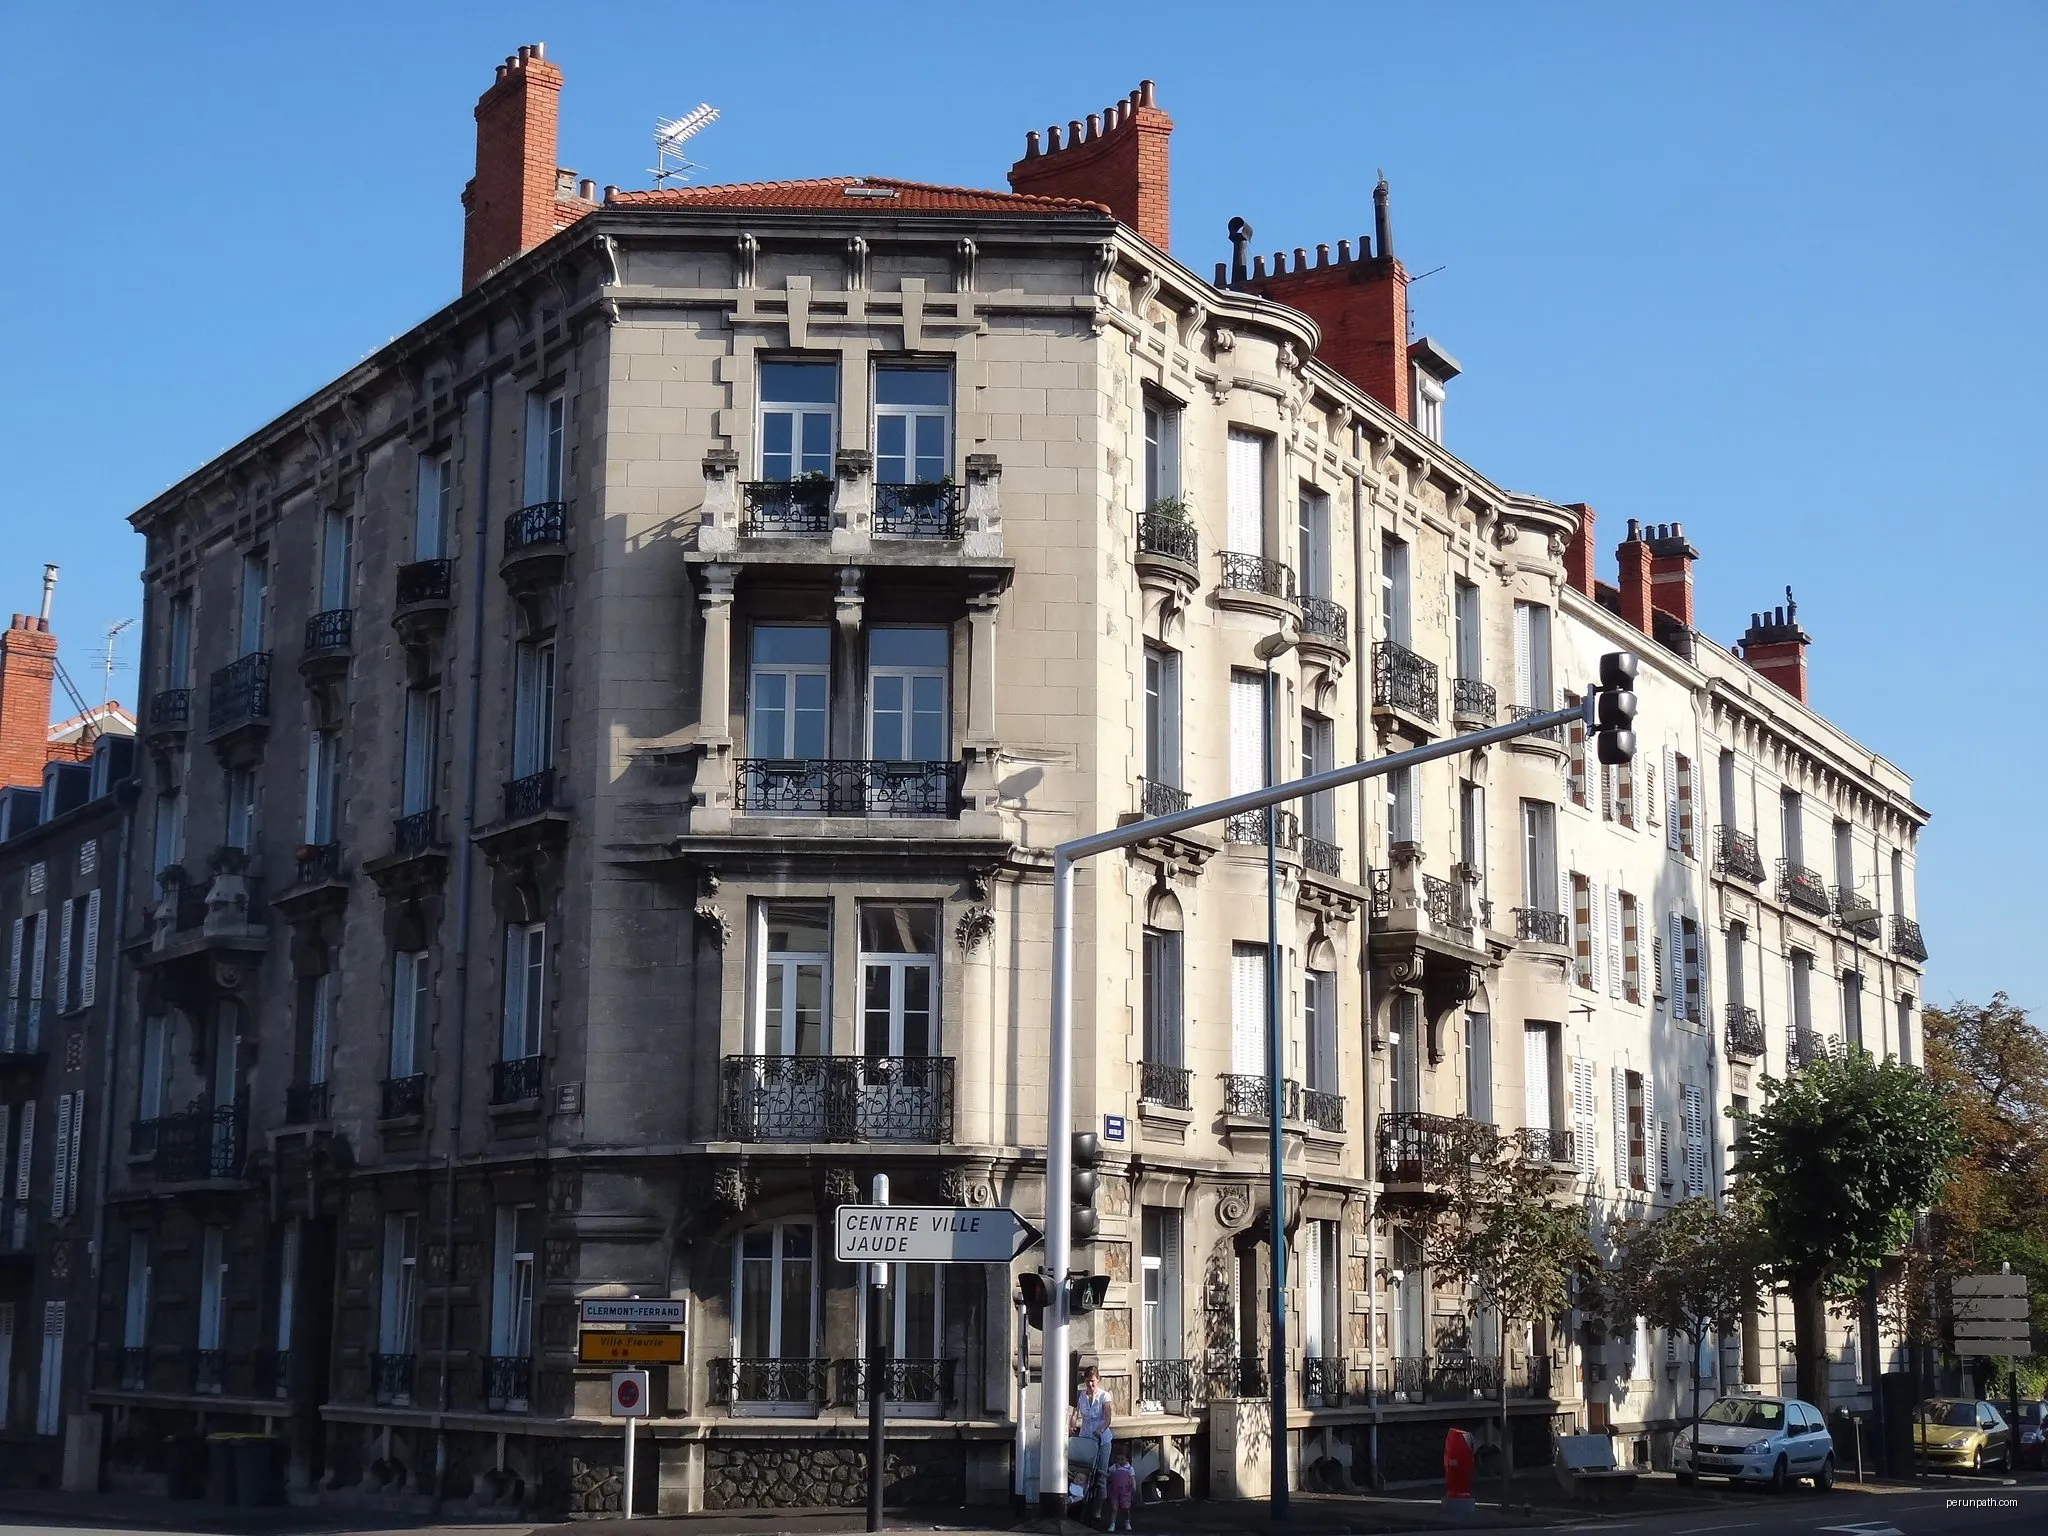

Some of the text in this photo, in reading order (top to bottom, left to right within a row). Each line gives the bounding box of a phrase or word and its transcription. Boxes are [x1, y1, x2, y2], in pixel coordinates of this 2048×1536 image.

[846, 1215, 980, 1233] CENTRE VILLE
[846, 1236, 909, 1252] JAUDE
[587, 1306, 679, 1316] CLERMONT-FERRAND
[600, 1337, 664, 1347] Ville Fleurie
